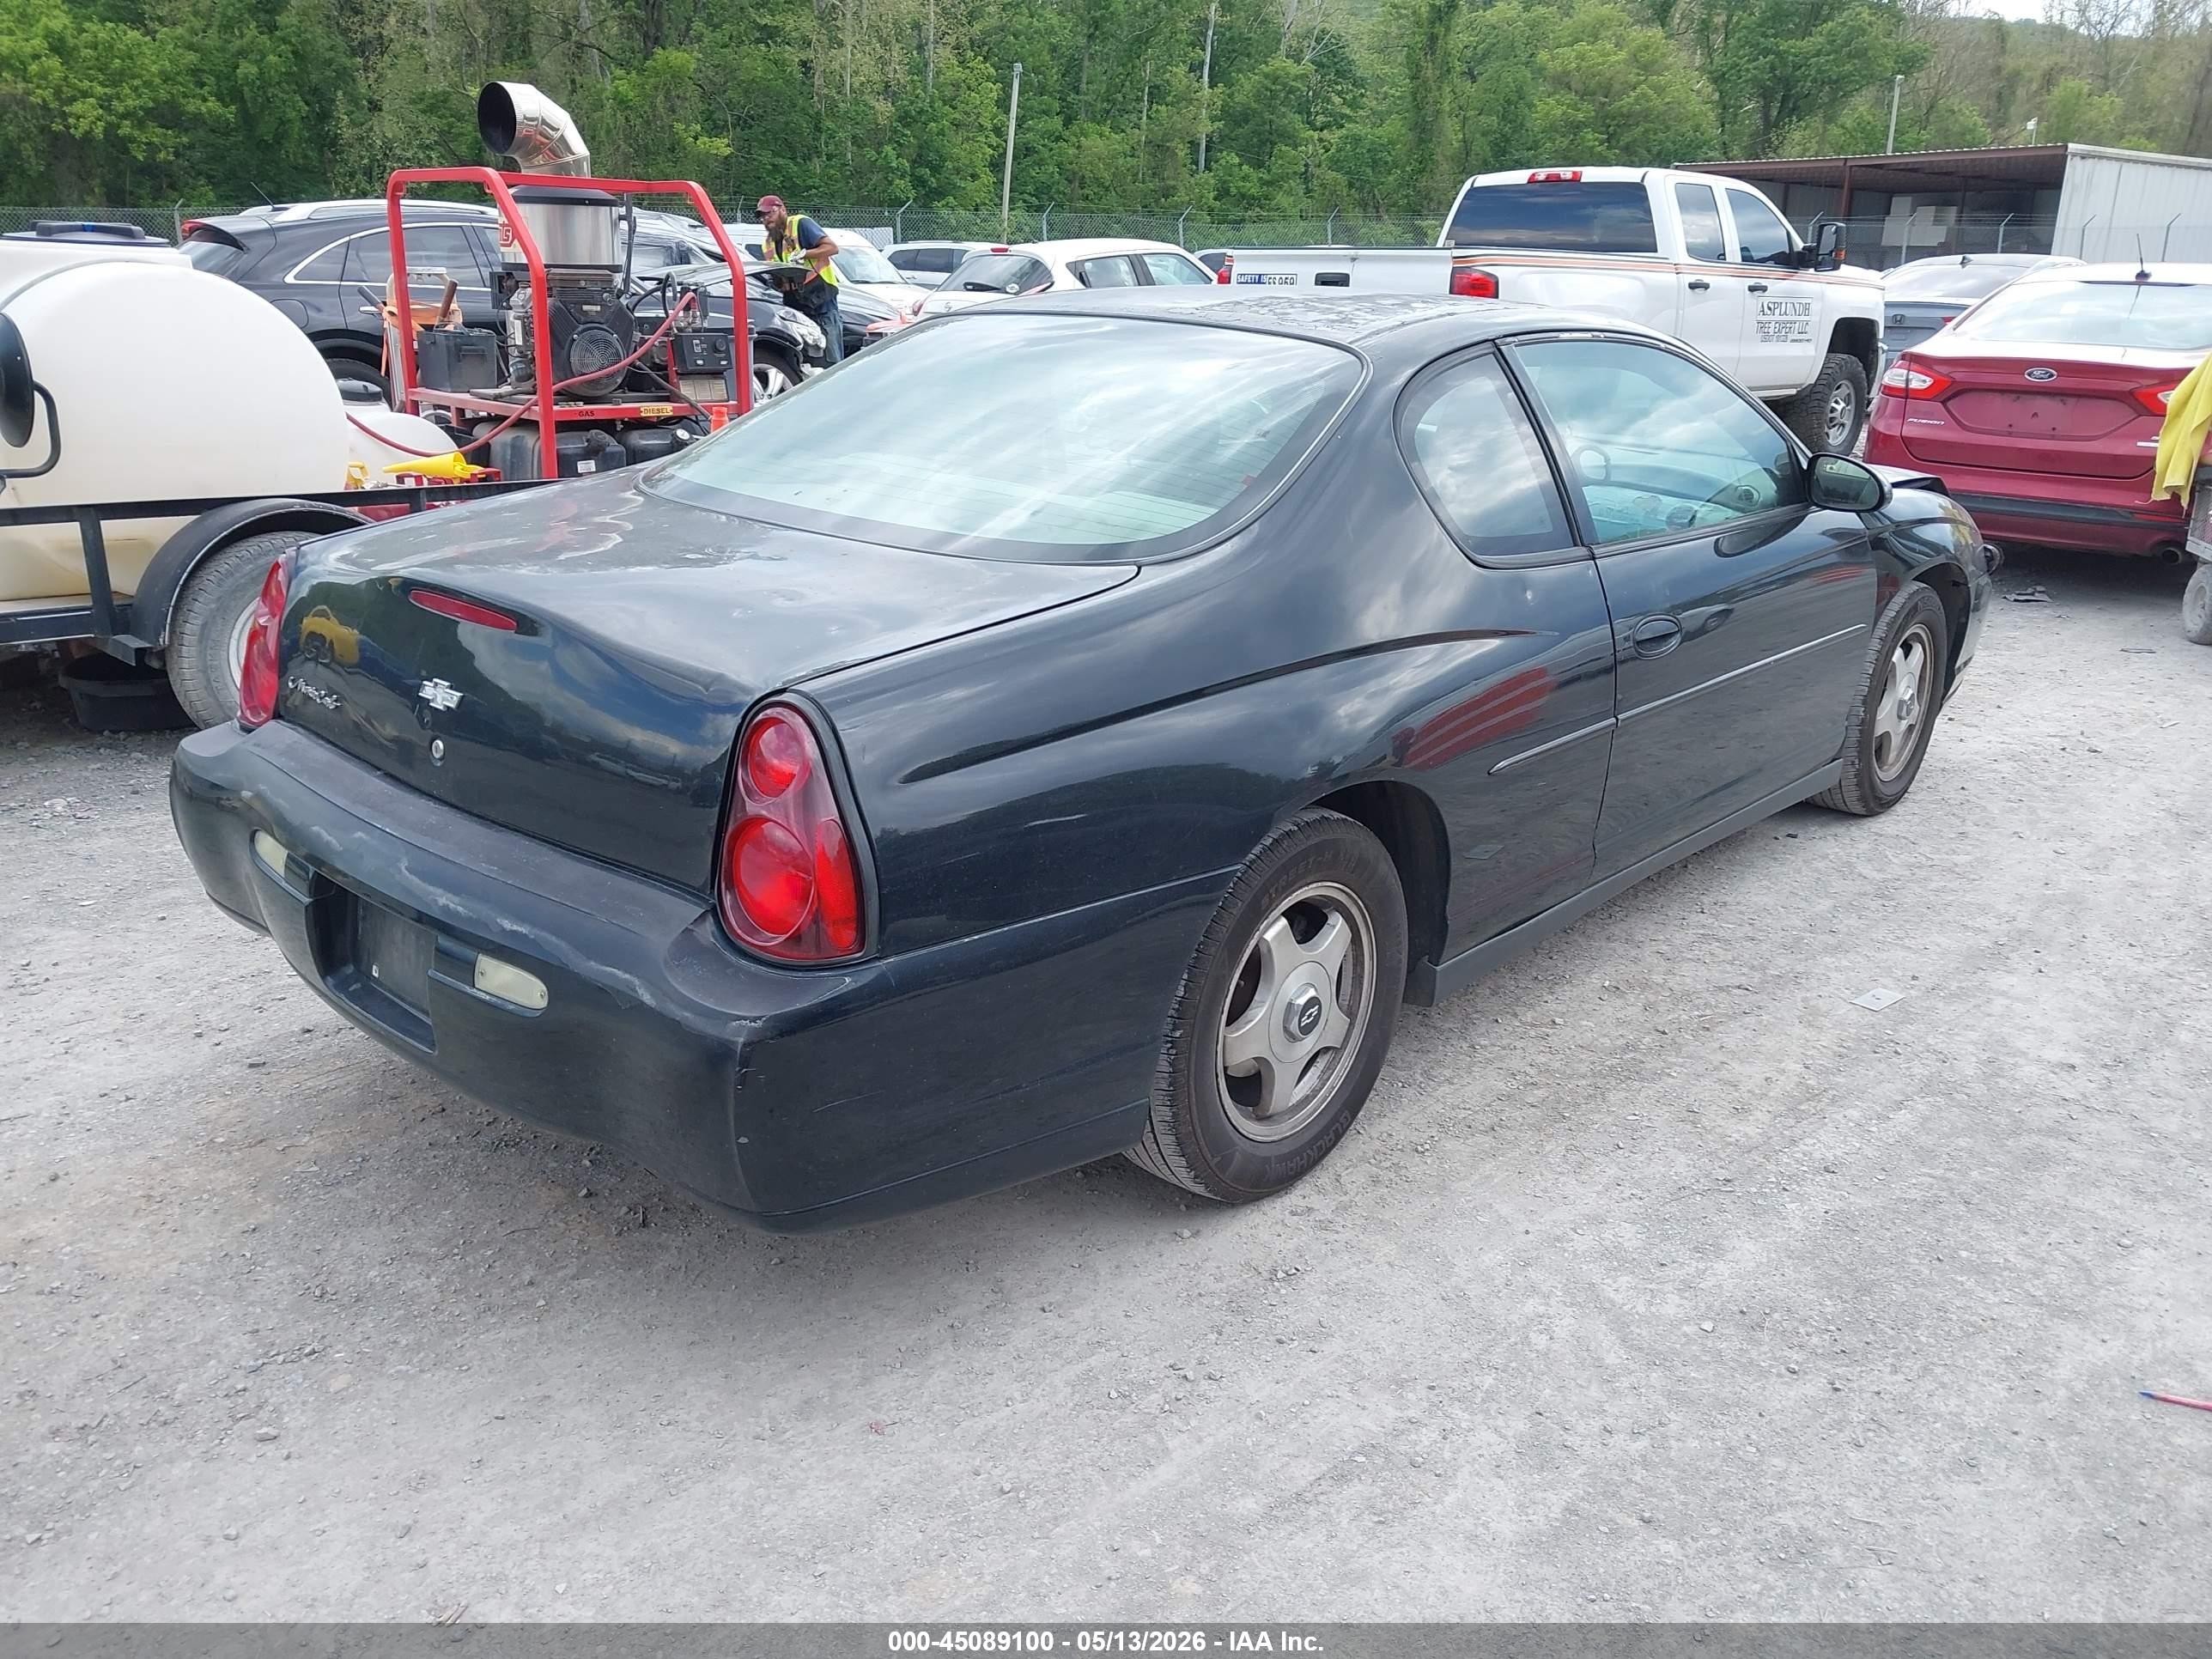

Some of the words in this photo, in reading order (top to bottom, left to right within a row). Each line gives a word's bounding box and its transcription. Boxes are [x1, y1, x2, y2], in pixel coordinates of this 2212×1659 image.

[1237, 274, 1260, 283] SAFETY
[1260, 274, 1267, 283] IS
[1758, 301, 1811, 317] ASPLUNDH
[1756, 321, 1772, 335] TREE
[1773, 321, 1797, 335] EXPERT
[1797, 322, 1809, 335] LLC
